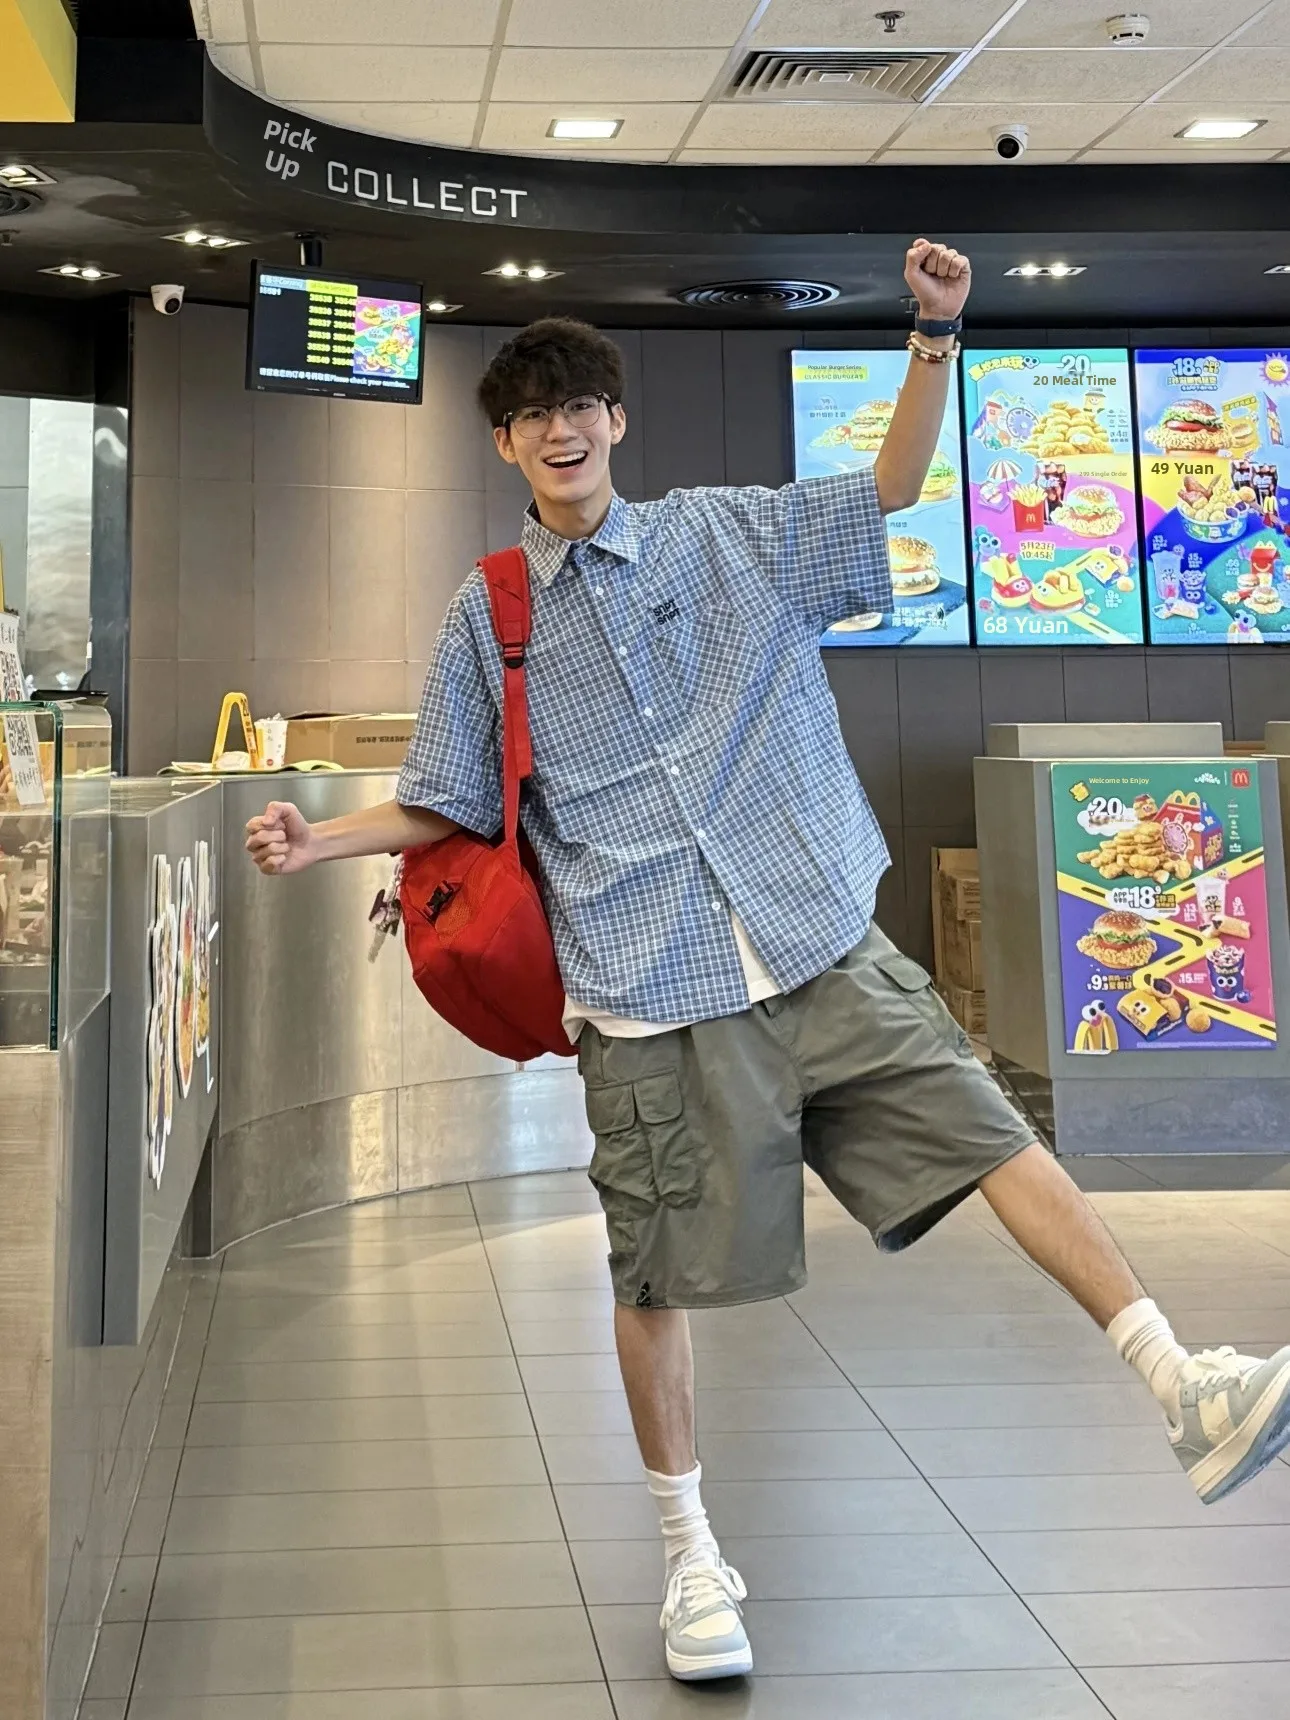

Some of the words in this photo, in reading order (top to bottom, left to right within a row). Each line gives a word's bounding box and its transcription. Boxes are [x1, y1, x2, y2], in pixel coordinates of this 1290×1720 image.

[263, 119, 318, 153] Pick
[264, 150, 300, 180] Up
[327, 160, 528, 218] COLLECT
[1061, 354, 1091, 374] 20
[350, 376, 367, 385] check
[367, 379, 382, 387] your
[1033, 375, 1049, 386] 20
[1052, 375, 1084, 386] Meal
[1086, 375, 1117, 386] Time
[1091, 470, 1109, 478] Single
[1151, 462, 1170, 475] 49
[1174, 462, 1214, 475] Yuan
[983, 616, 1008, 634] 68
[1015, 616, 1069, 634] Yuan
[1088, 776, 1121, 785] Welcome
[1121, 777, 1129, 785] to
[1129, 776, 1150, 786] Enjoy
